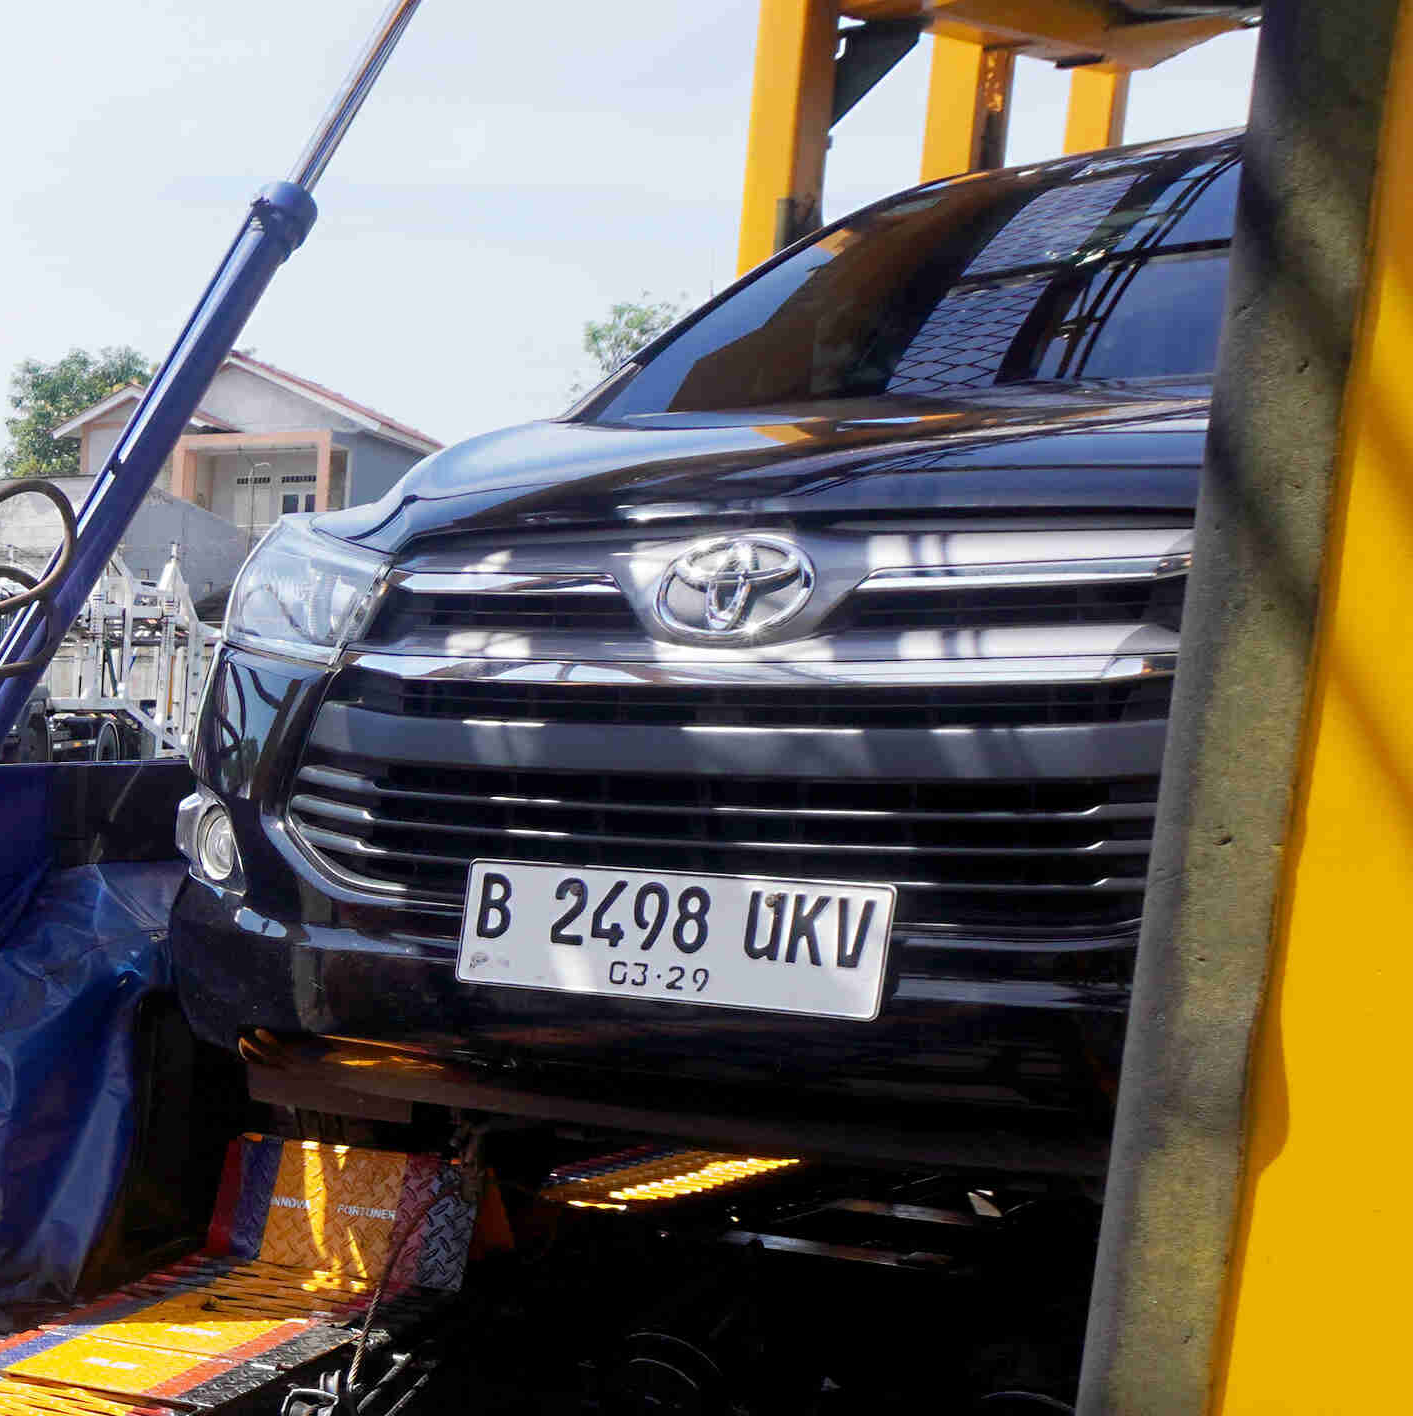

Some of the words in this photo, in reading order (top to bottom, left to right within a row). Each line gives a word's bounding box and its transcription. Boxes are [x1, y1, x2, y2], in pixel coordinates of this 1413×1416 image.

[475, 871, 514, 940] B
[549, 876, 713, 955] 2498
[742, 889, 878, 969] UKV
[336, 1204, 397, 1221] FORTUNER
